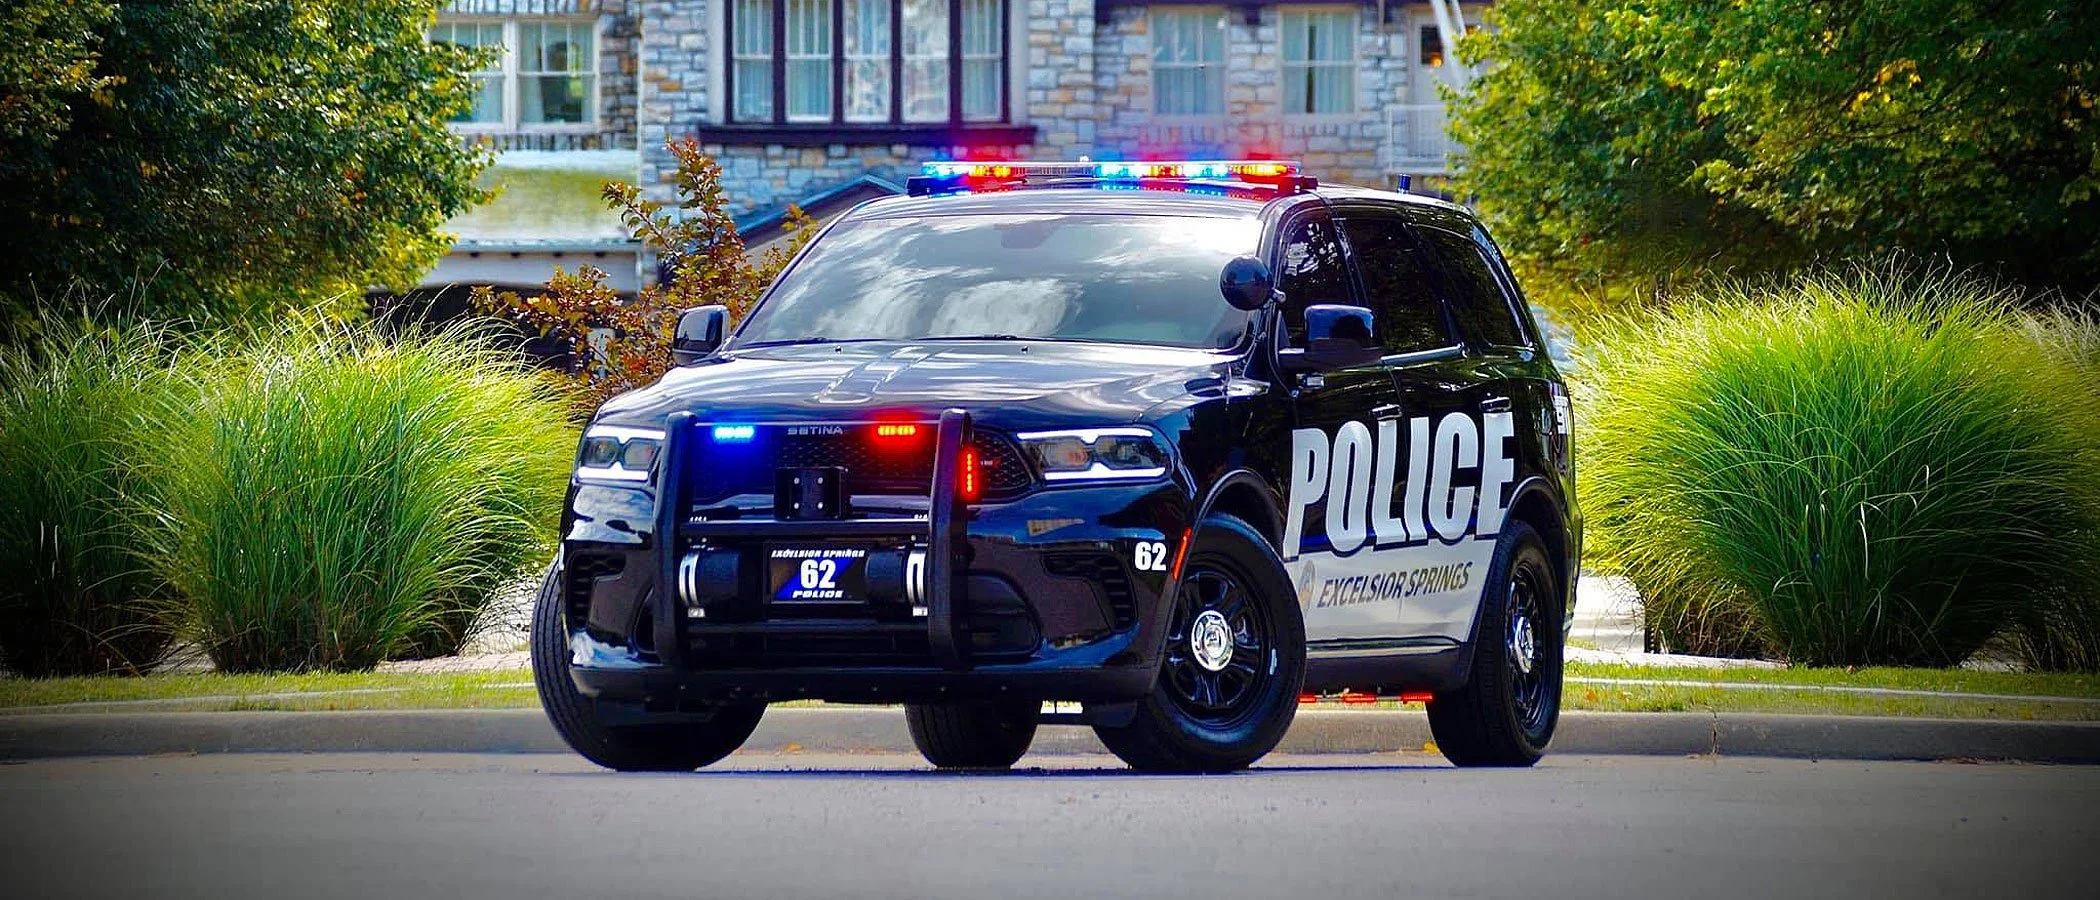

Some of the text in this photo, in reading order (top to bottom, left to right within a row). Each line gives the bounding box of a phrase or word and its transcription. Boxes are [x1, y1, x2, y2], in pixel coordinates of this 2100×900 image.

[1283, 412, 1514, 559] POLICE
[1134, 541, 1167, 571] 62
[800, 559, 836, 589] 62
[1316, 561, 1474, 608] EXCELSIOR SPRINGS
[792, 590, 844, 599] POLICE
